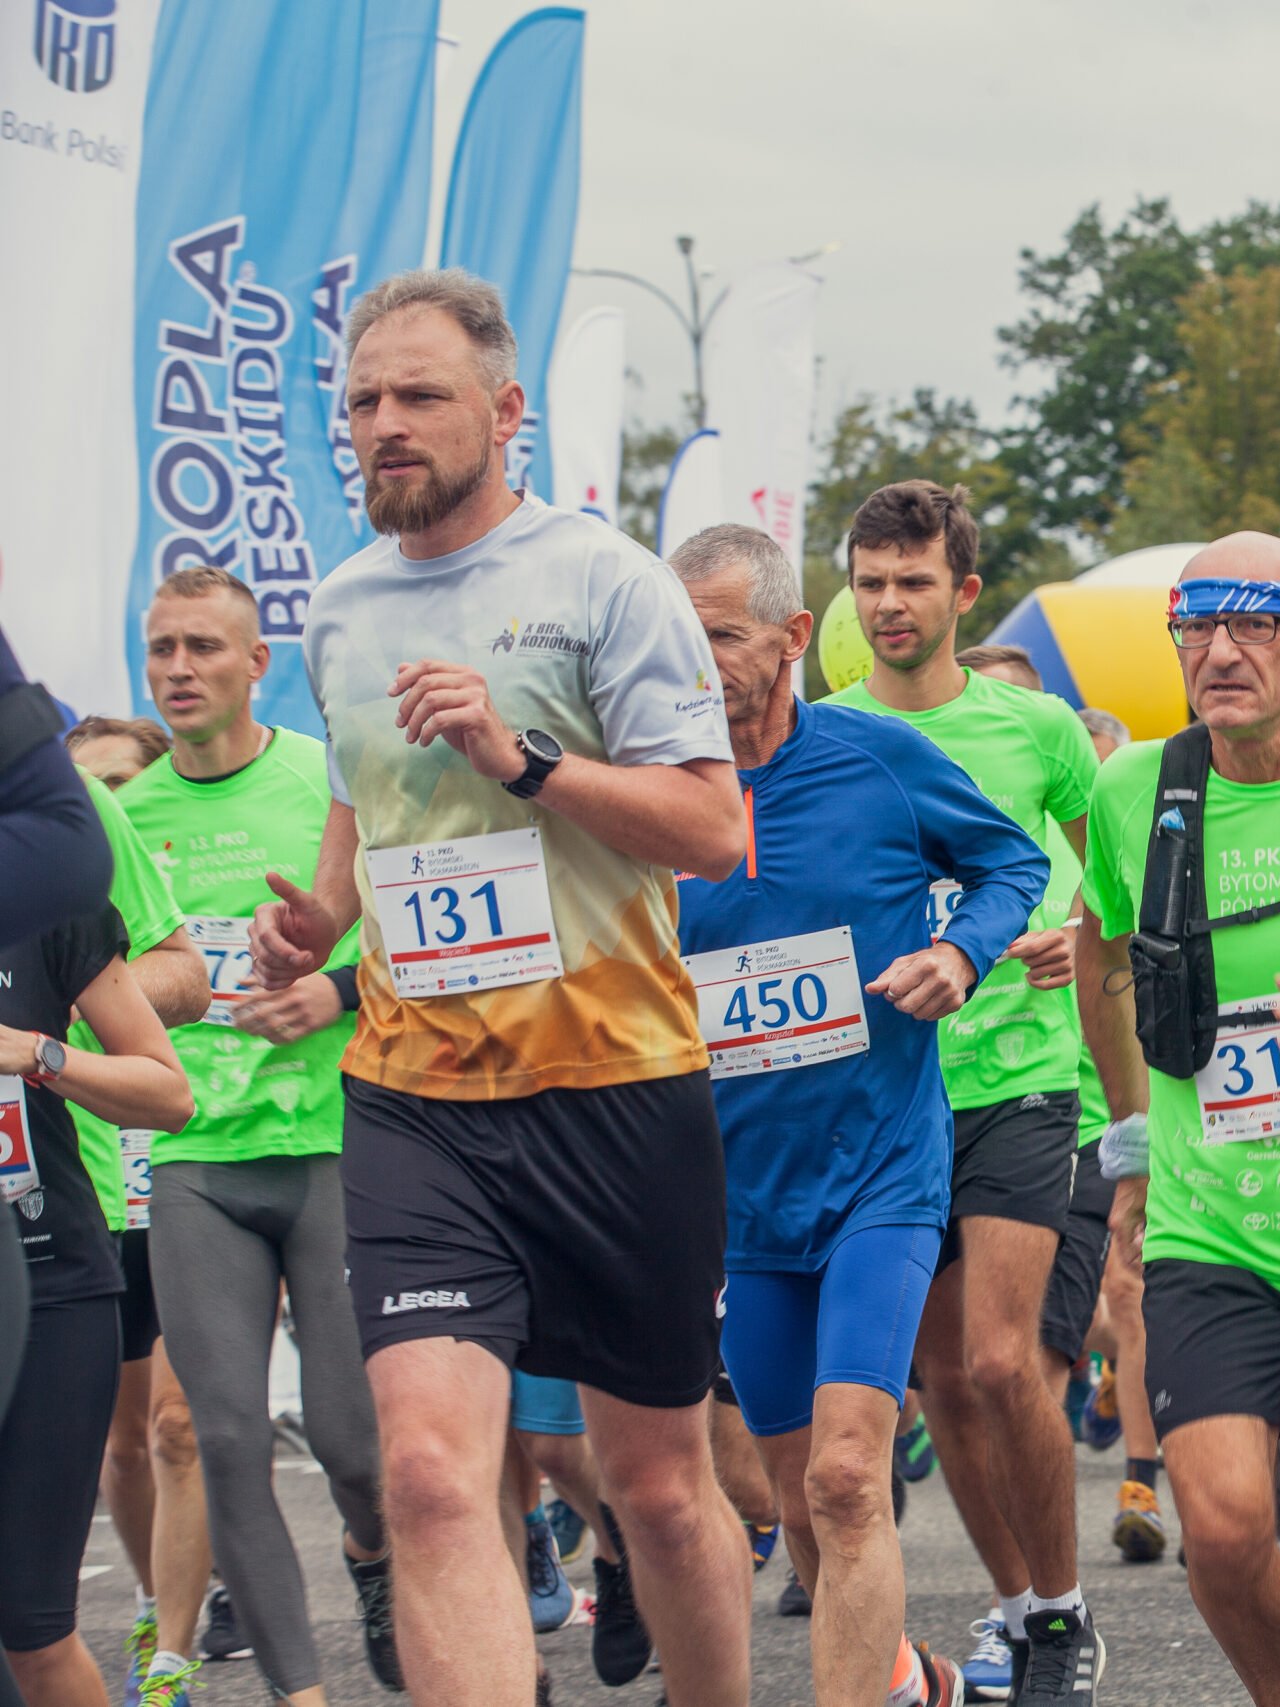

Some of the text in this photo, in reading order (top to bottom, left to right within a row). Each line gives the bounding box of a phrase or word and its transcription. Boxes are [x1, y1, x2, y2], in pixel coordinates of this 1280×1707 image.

[1, 110, 58, 152] Bank
[148, 215, 246, 600] ROPLA
[228, 280, 318, 643] BESKIDU
[525, 623, 565, 635] X BIEG
[1219, 849, 1246, 868] 13.
[404, 880, 503, 946] 131
[723, 972, 828, 1033] 450
[764, 1028, 794, 1042] Krzysztof
[383, 1290, 471, 1315] LEGEA
